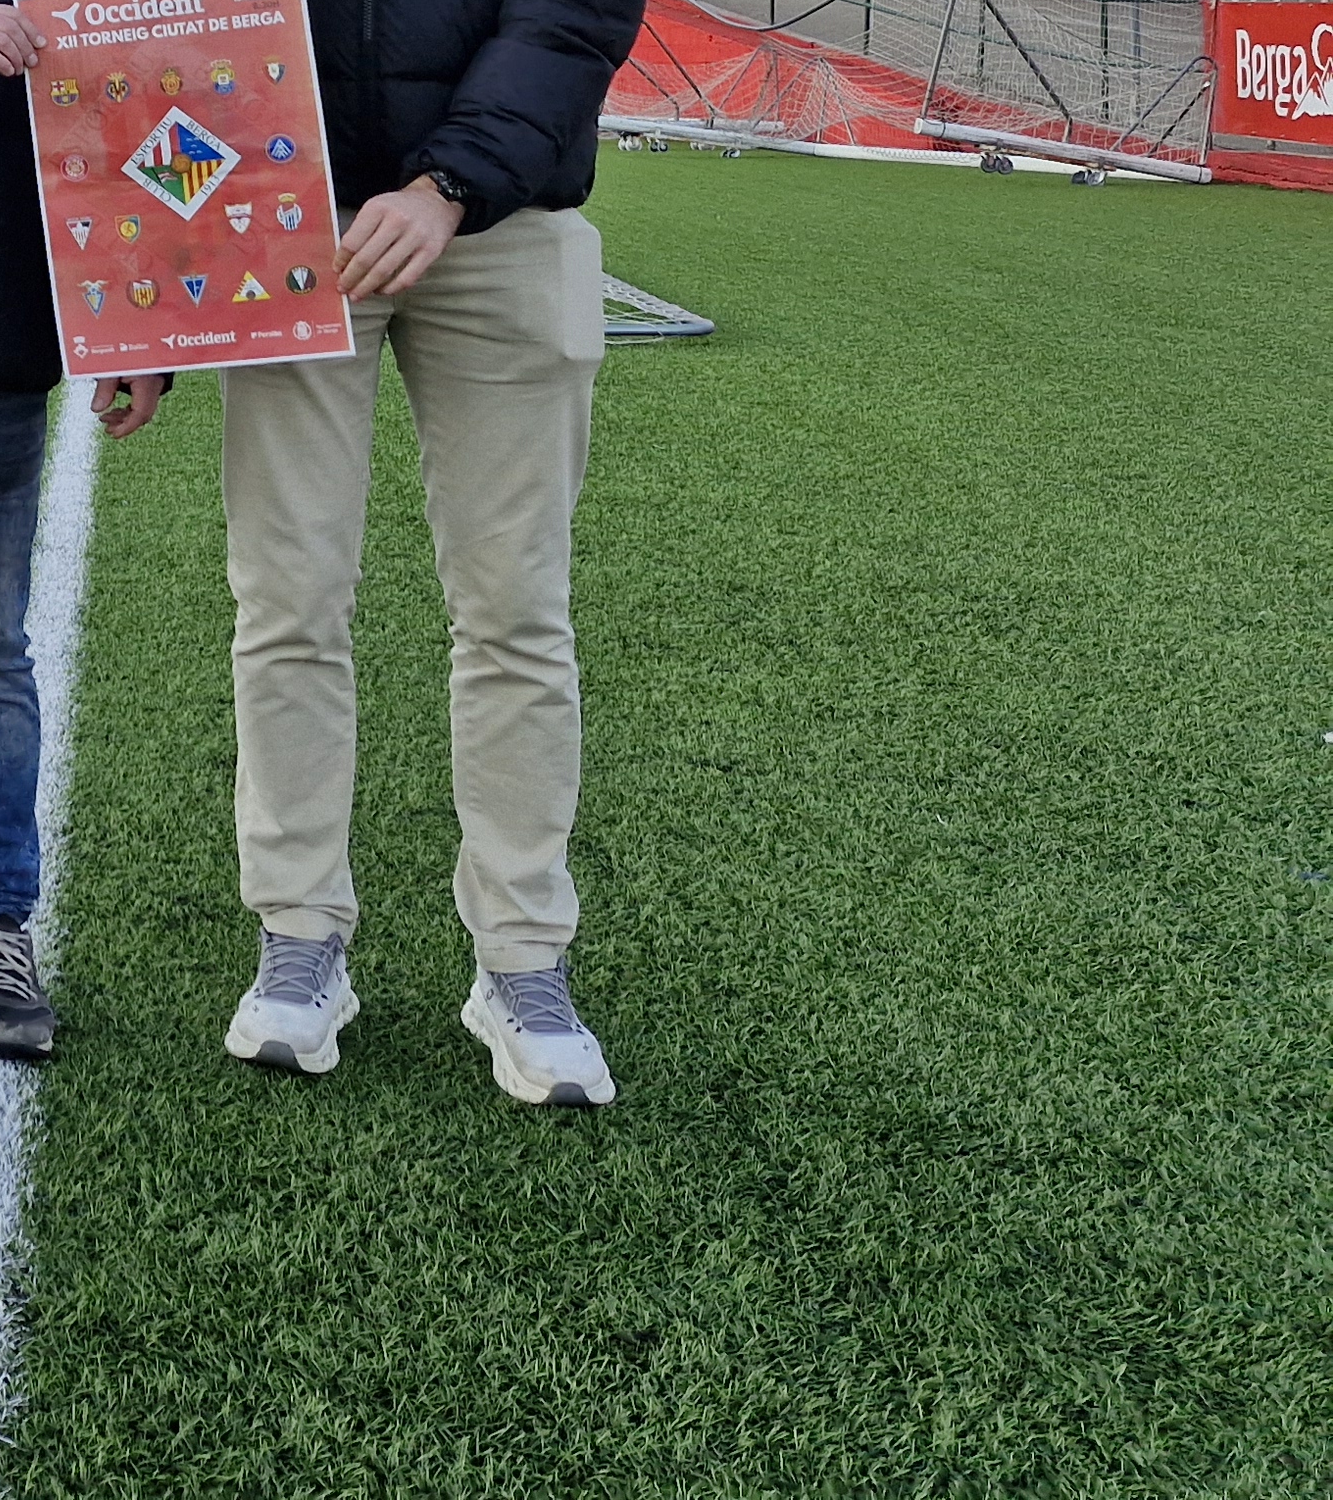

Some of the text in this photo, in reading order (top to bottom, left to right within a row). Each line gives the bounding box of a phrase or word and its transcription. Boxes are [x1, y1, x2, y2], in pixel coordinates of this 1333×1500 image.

[56, 11, 285, 50] XII TORNEIG CIUTAT DE BERGA
[1235, 28, 1308, 117] Berga
[131, 117, 173, 165] ESPORTIU
[186, 120, 221, 151] BERGA
[142, 177, 172, 202] CLUB
[177, 330, 236, 348] Occident
